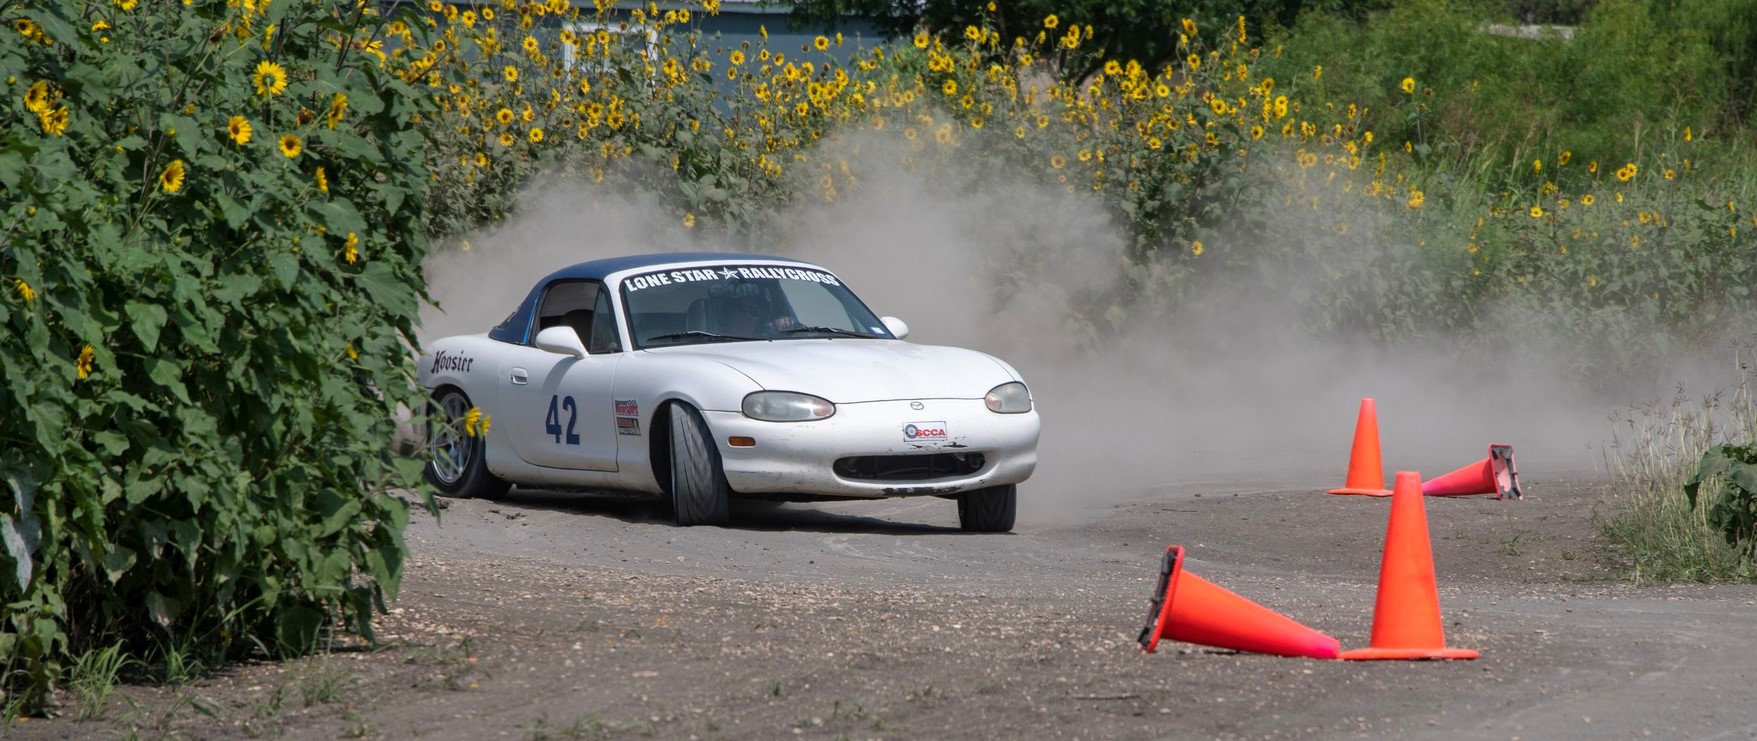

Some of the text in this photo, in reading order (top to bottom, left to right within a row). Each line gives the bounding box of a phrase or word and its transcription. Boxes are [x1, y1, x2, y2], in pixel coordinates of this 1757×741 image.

[624, 267, 840, 292] LONE STAR RALLYCROSS
[430, 350, 474, 374] Hoosier
[545, 394, 580, 445] 42
[915, 429, 946, 437] SCCA
